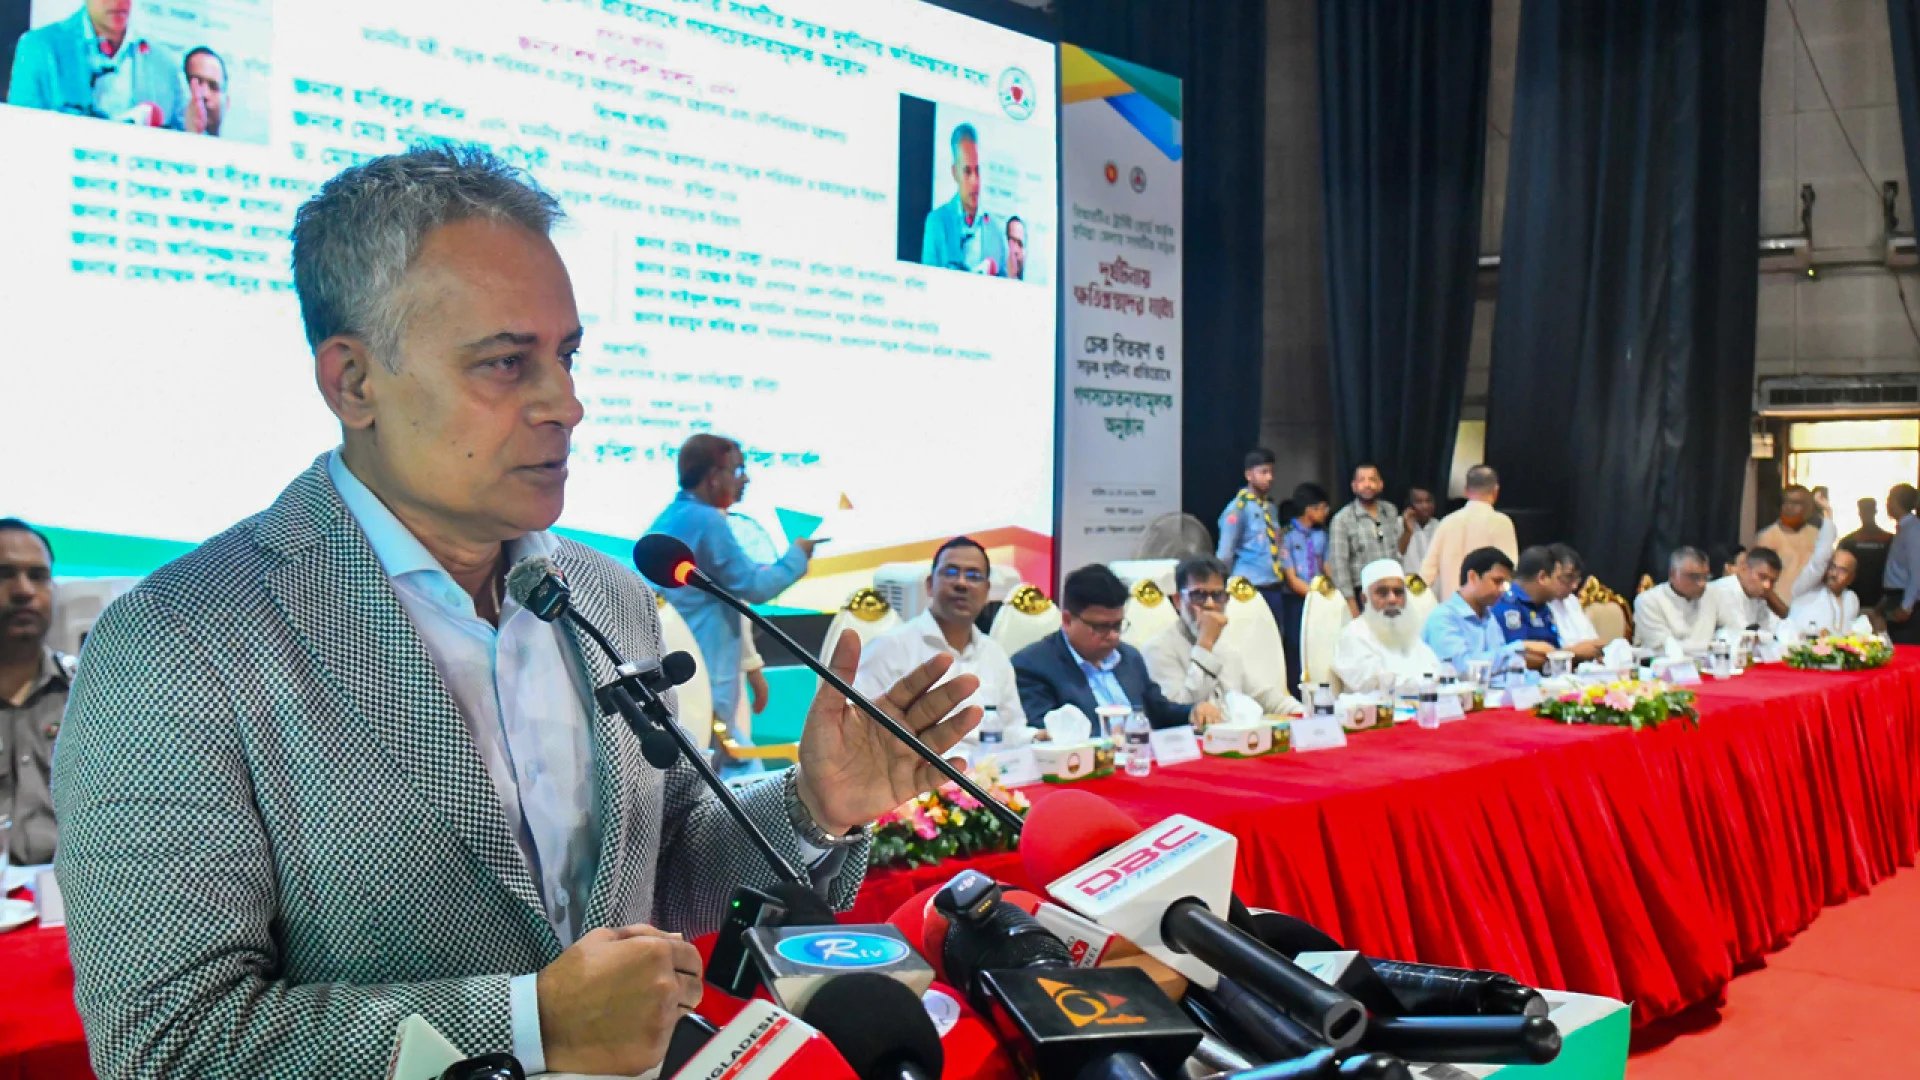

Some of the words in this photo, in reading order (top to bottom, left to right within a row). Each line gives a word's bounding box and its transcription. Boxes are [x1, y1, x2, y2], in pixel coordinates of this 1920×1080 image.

[293, 78, 344, 102] জনাব
[292, 110, 343, 133] জনাব
[73, 148, 119, 165] জনাব
[72, 176, 118, 194] জনাব
[71, 203, 118, 221] জনাব
[71, 231, 117, 248] জনাব
[636, 236, 665, 248] জনাব
[70, 259, 118, 275] জনাব
[636, 262, 665, 274] জনাব
[1099, 255, 1151, 289] দুর্ঘটনায়
[635, 287, 664, 299] জনাব
[632, 311, 665, 324] জনাব
[1084, 335, 1108, 353] চেক
[1113, 333, 1150, 360] বিতরণ
[1155, 344, 1164, 361] ও
[1073, 386, 1172, 417] গণসচেতনতামূলক
[1103, 411, 1144, 439] অনুষ্ঠান
[1074, 825, 1200, 896] DBC
[815, 938, 883, 960] Rtv
